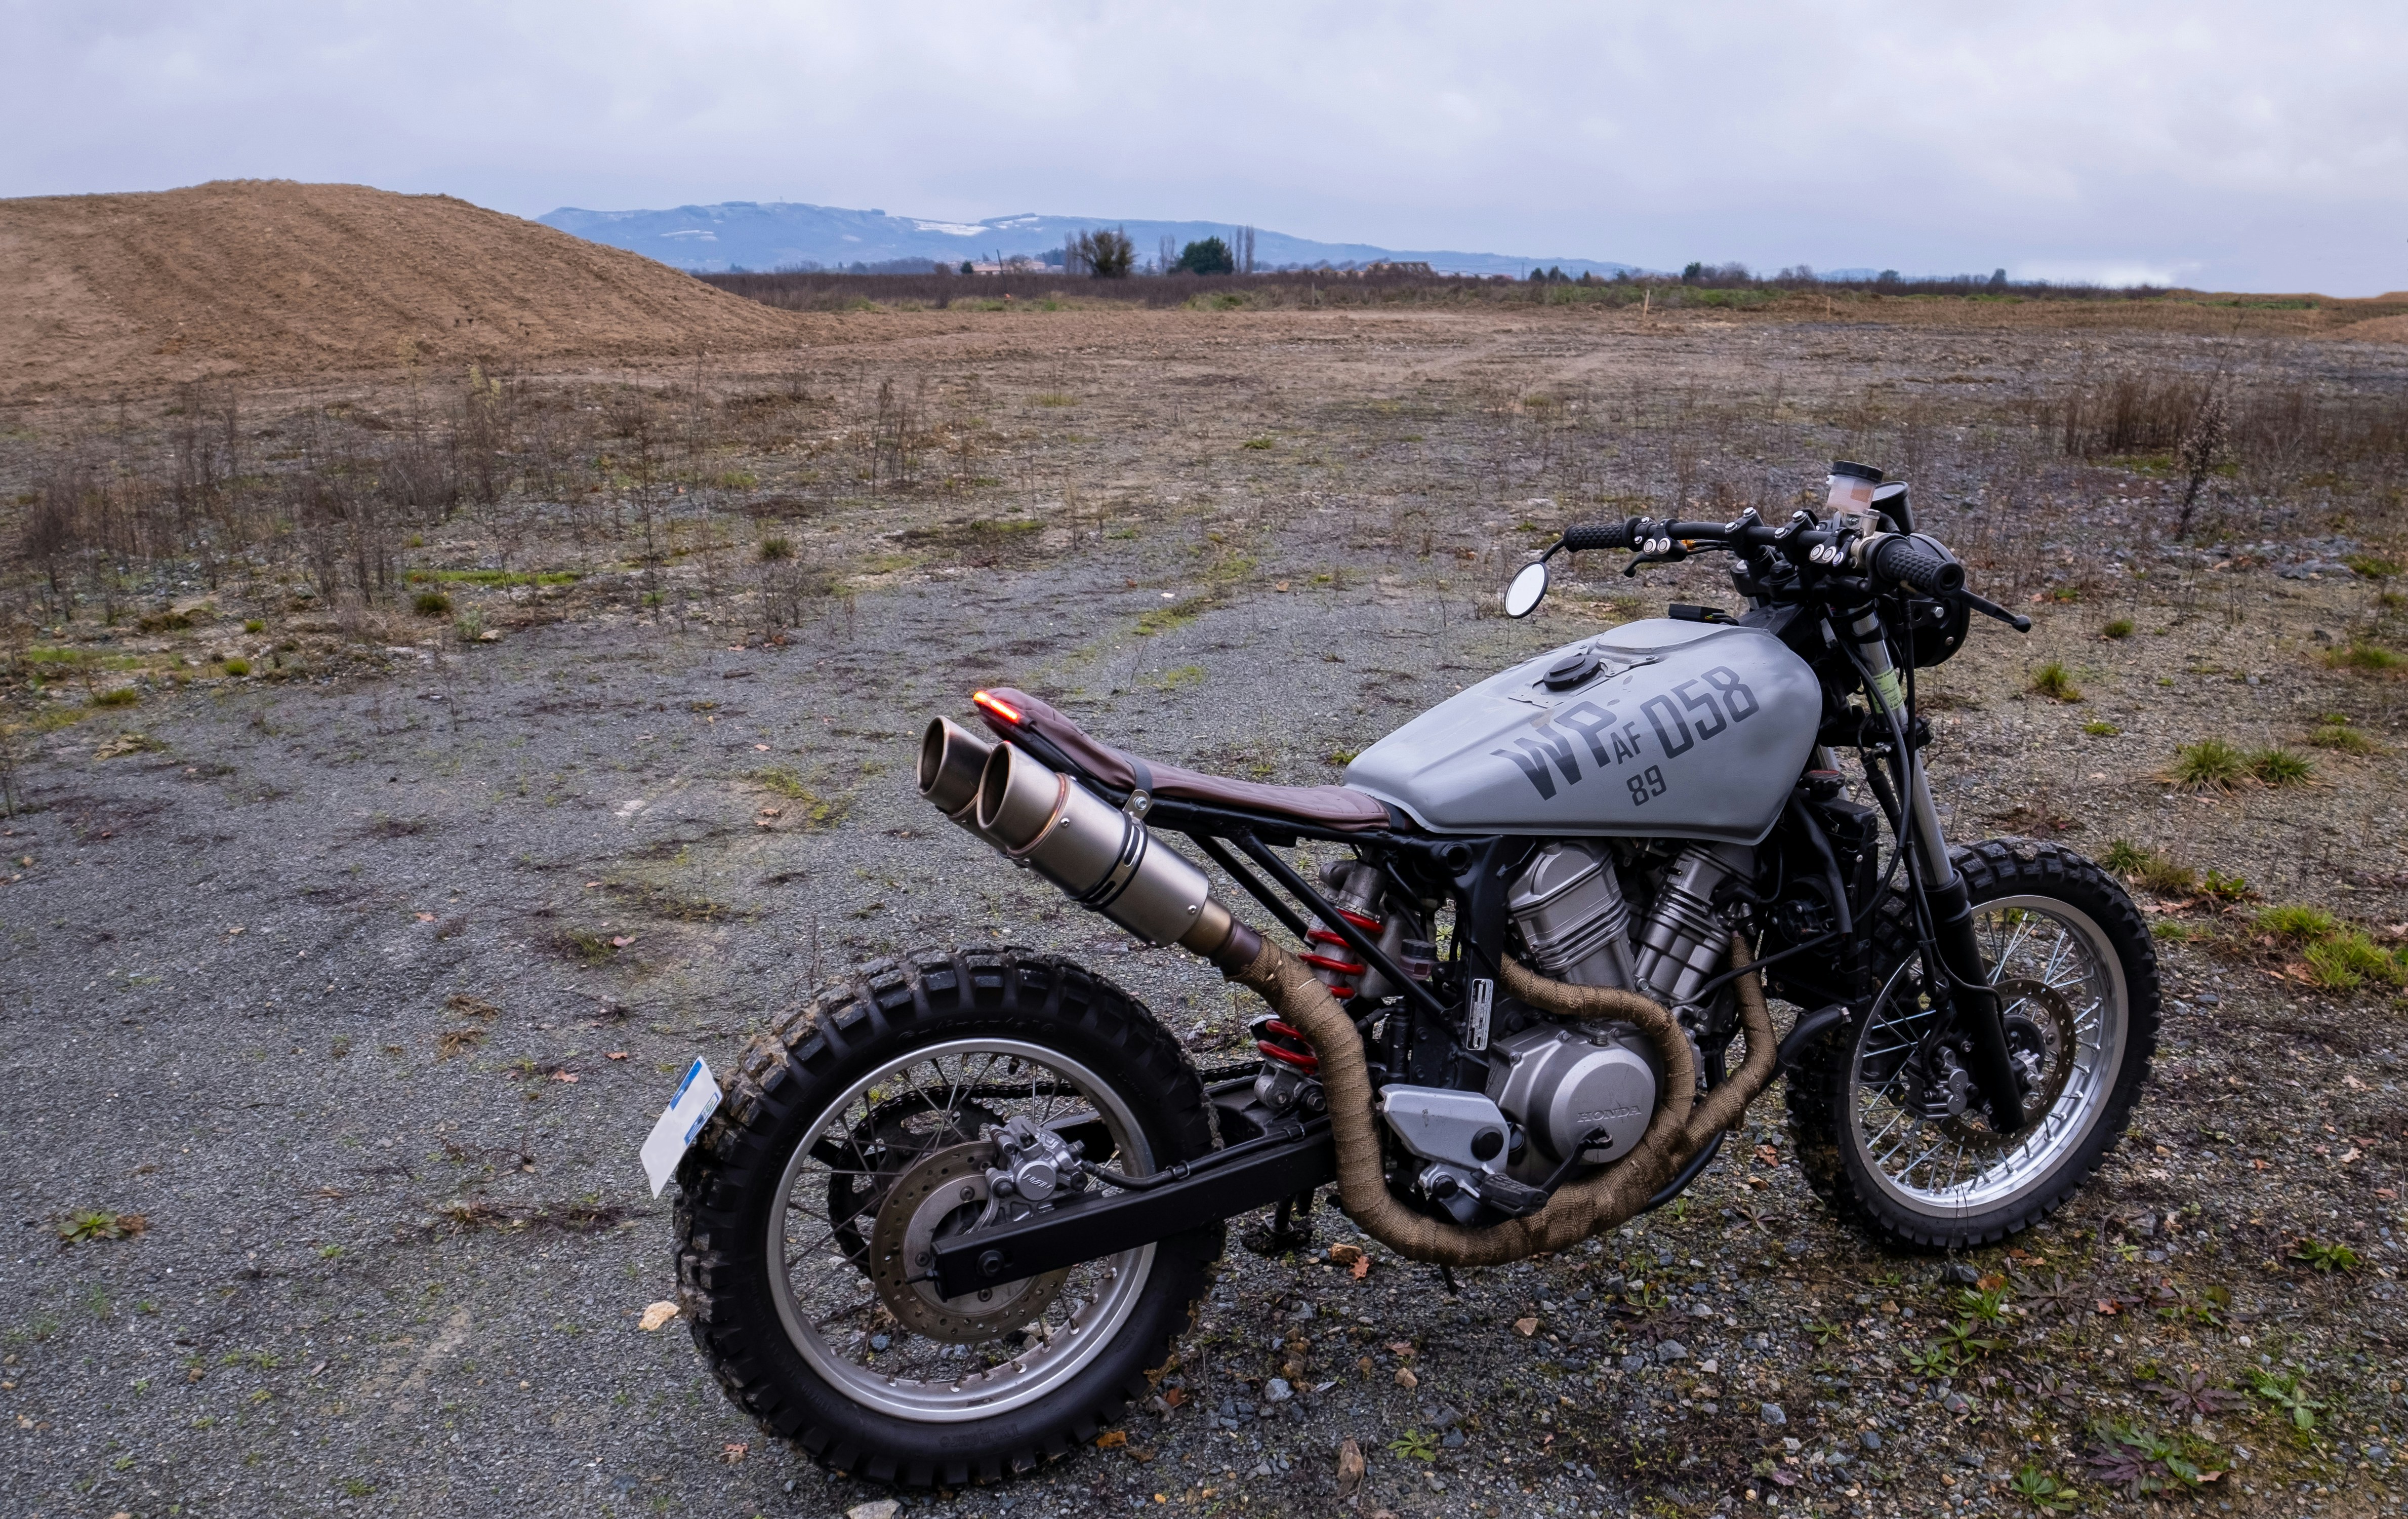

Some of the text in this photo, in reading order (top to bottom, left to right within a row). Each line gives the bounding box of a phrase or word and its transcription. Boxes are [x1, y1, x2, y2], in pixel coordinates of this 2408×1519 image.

[1490, 701, 1617, 801] WP
[1610, 721, 1641, 765] AF
[1626, 765, 1667, 806] 89
[1577, 1105, 1642, 1123] HONDA
[940, 1423, 1023, 1448] Twinduro
